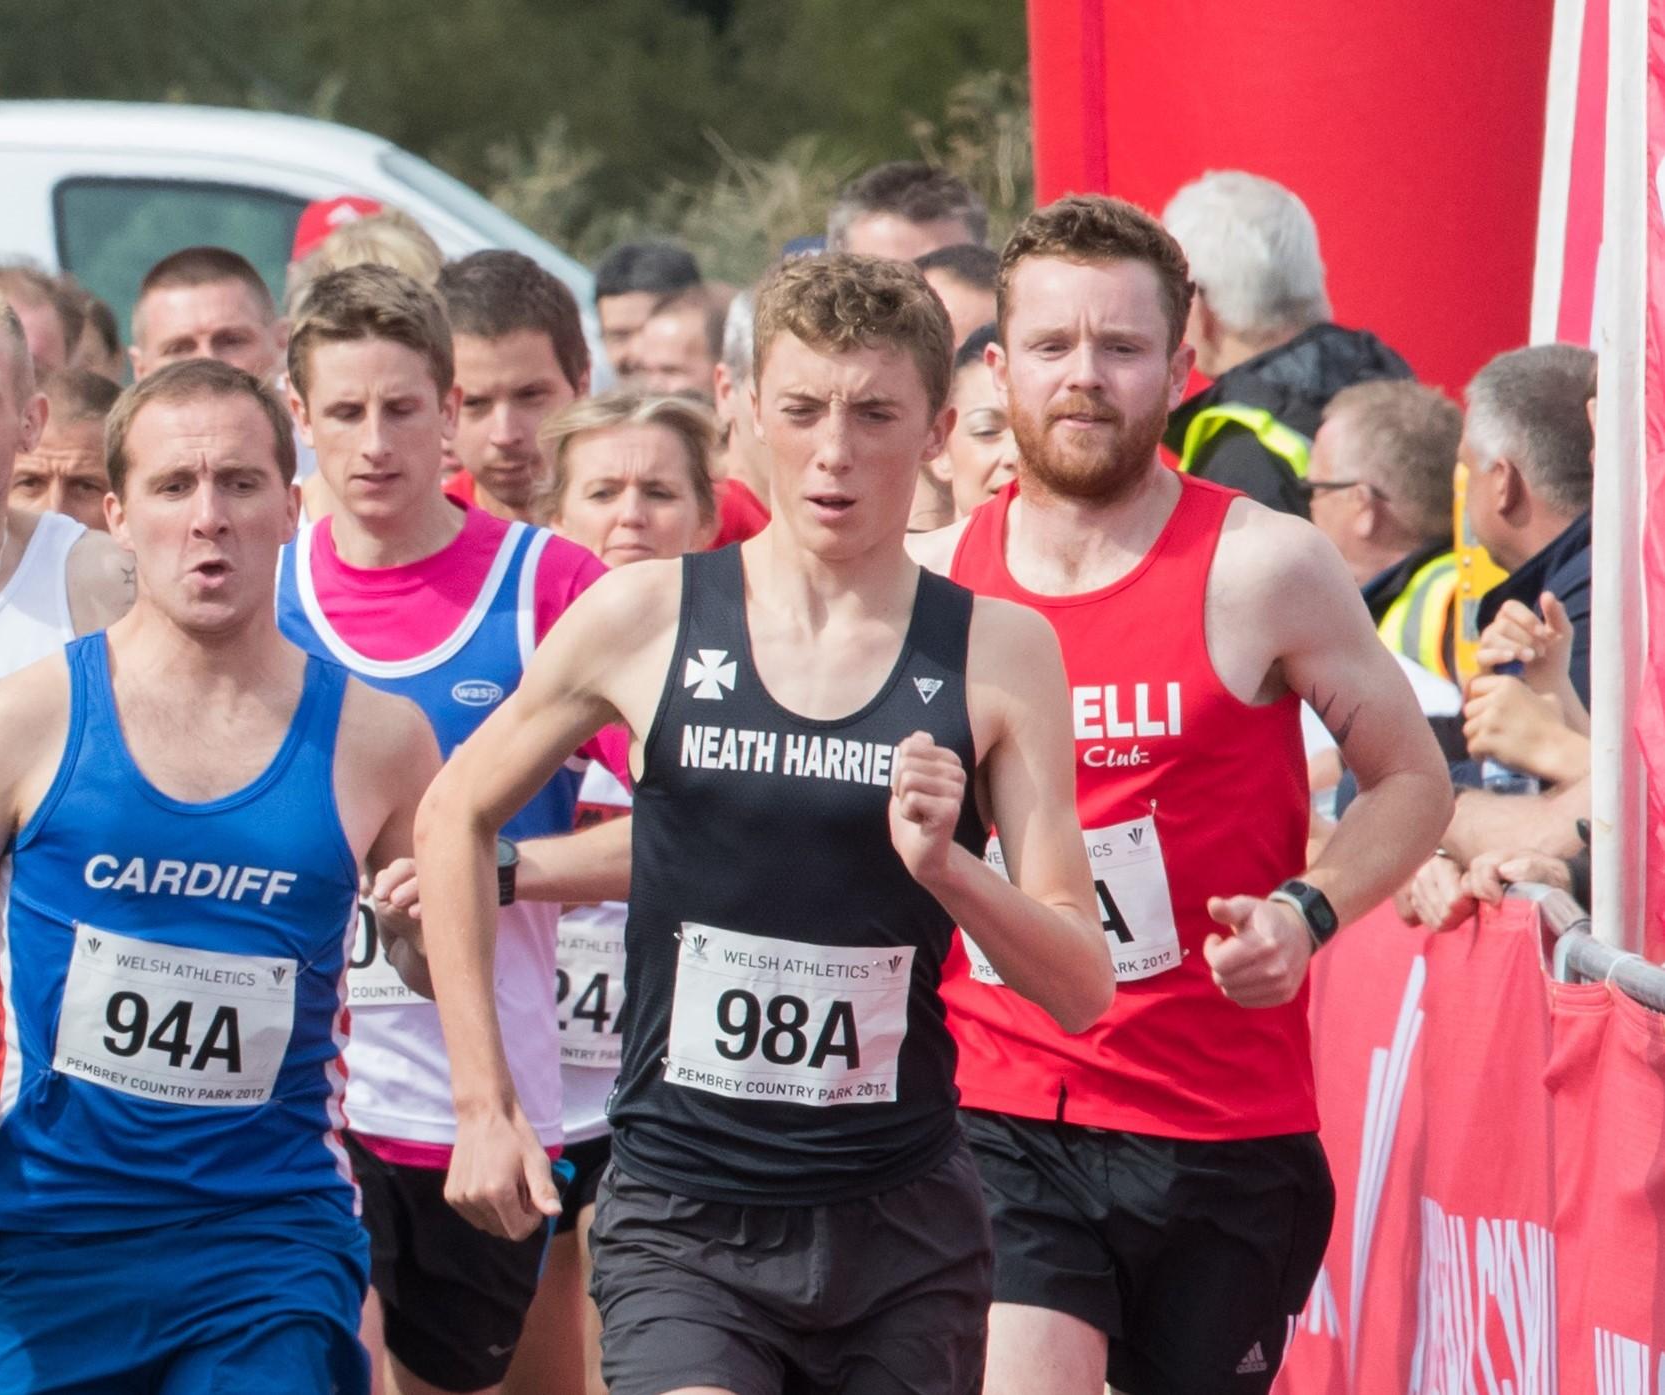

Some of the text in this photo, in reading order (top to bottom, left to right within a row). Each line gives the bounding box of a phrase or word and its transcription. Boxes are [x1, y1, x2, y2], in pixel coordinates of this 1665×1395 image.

[680, 724, 900, 787] NEATH HARRIE
[84, 854, 297, 905] CARDIFF
[117, 953, 256, 986] WELSH ATHLETICS
[724, 950, 870, 978] WELSH ATHLETICS
[103, 991, 242, 1073] 94A
[715, 989, 860, 1070] 98A
[67, 1057, 264, 1099] PEMBREY COUNTRY PARK 2017
[677, 1067, 886, 1101] PEMBREY COUNTRY PARK 2017
